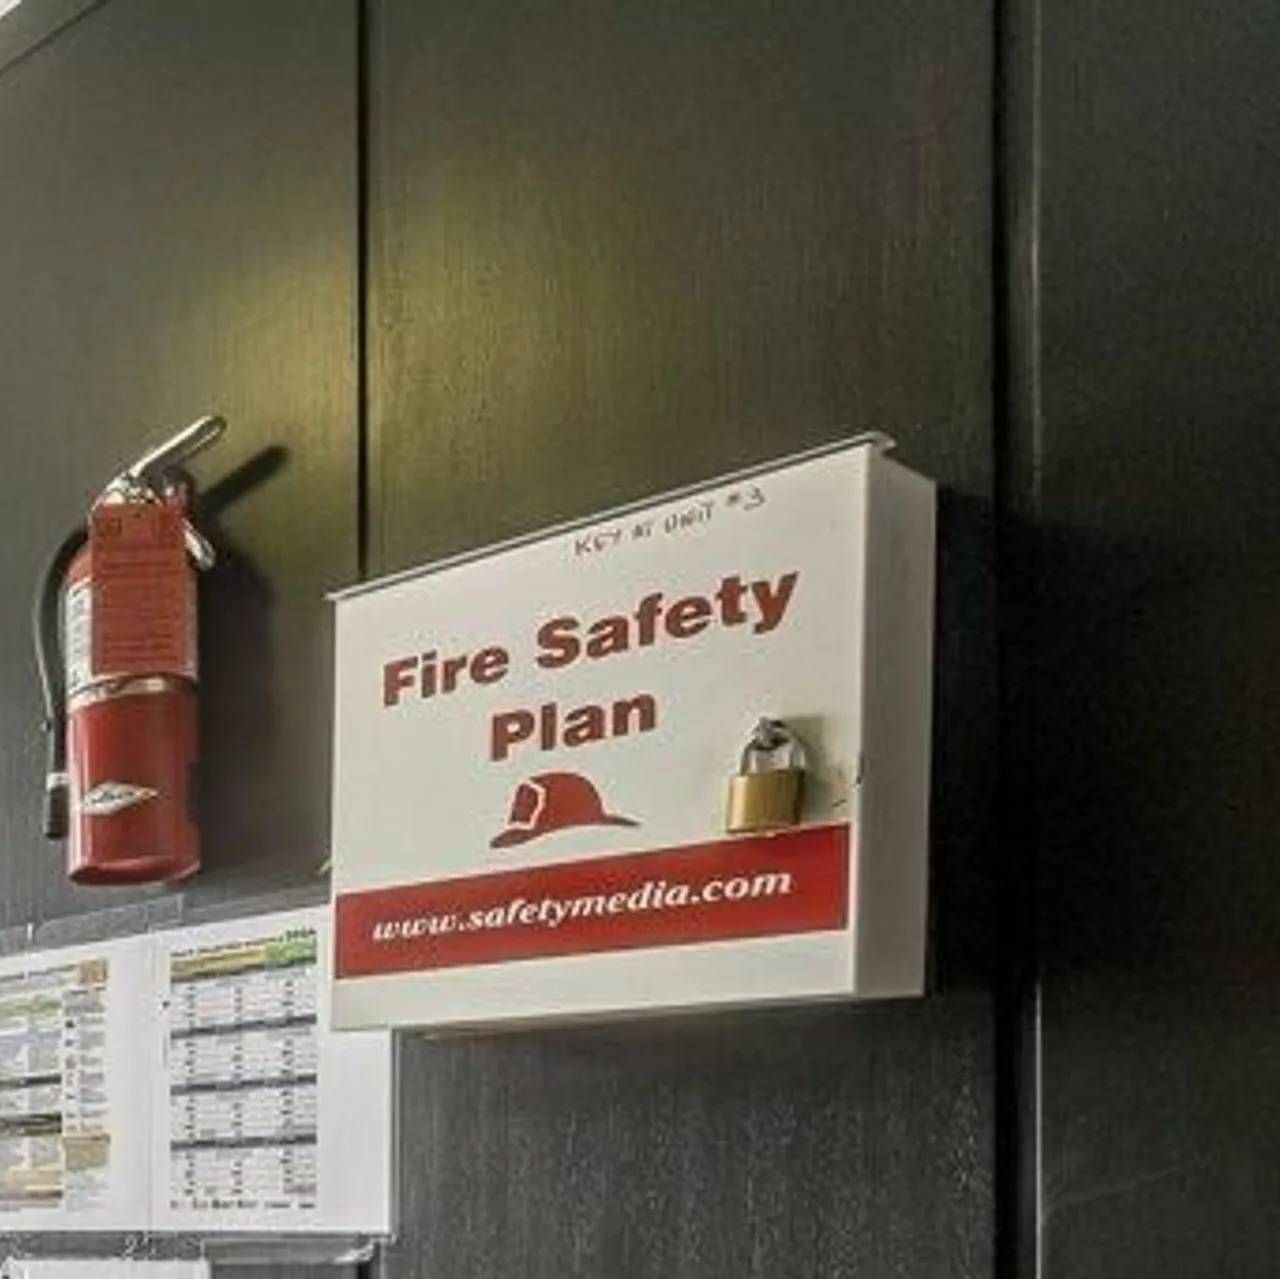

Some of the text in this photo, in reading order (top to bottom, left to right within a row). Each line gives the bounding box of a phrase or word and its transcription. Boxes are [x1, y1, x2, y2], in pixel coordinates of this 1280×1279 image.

[382, 571, 799, 707] Fire Safety
[490, 693, 657, 762] Plan
[371, 871, 793, 942] www.safetymedia.com
